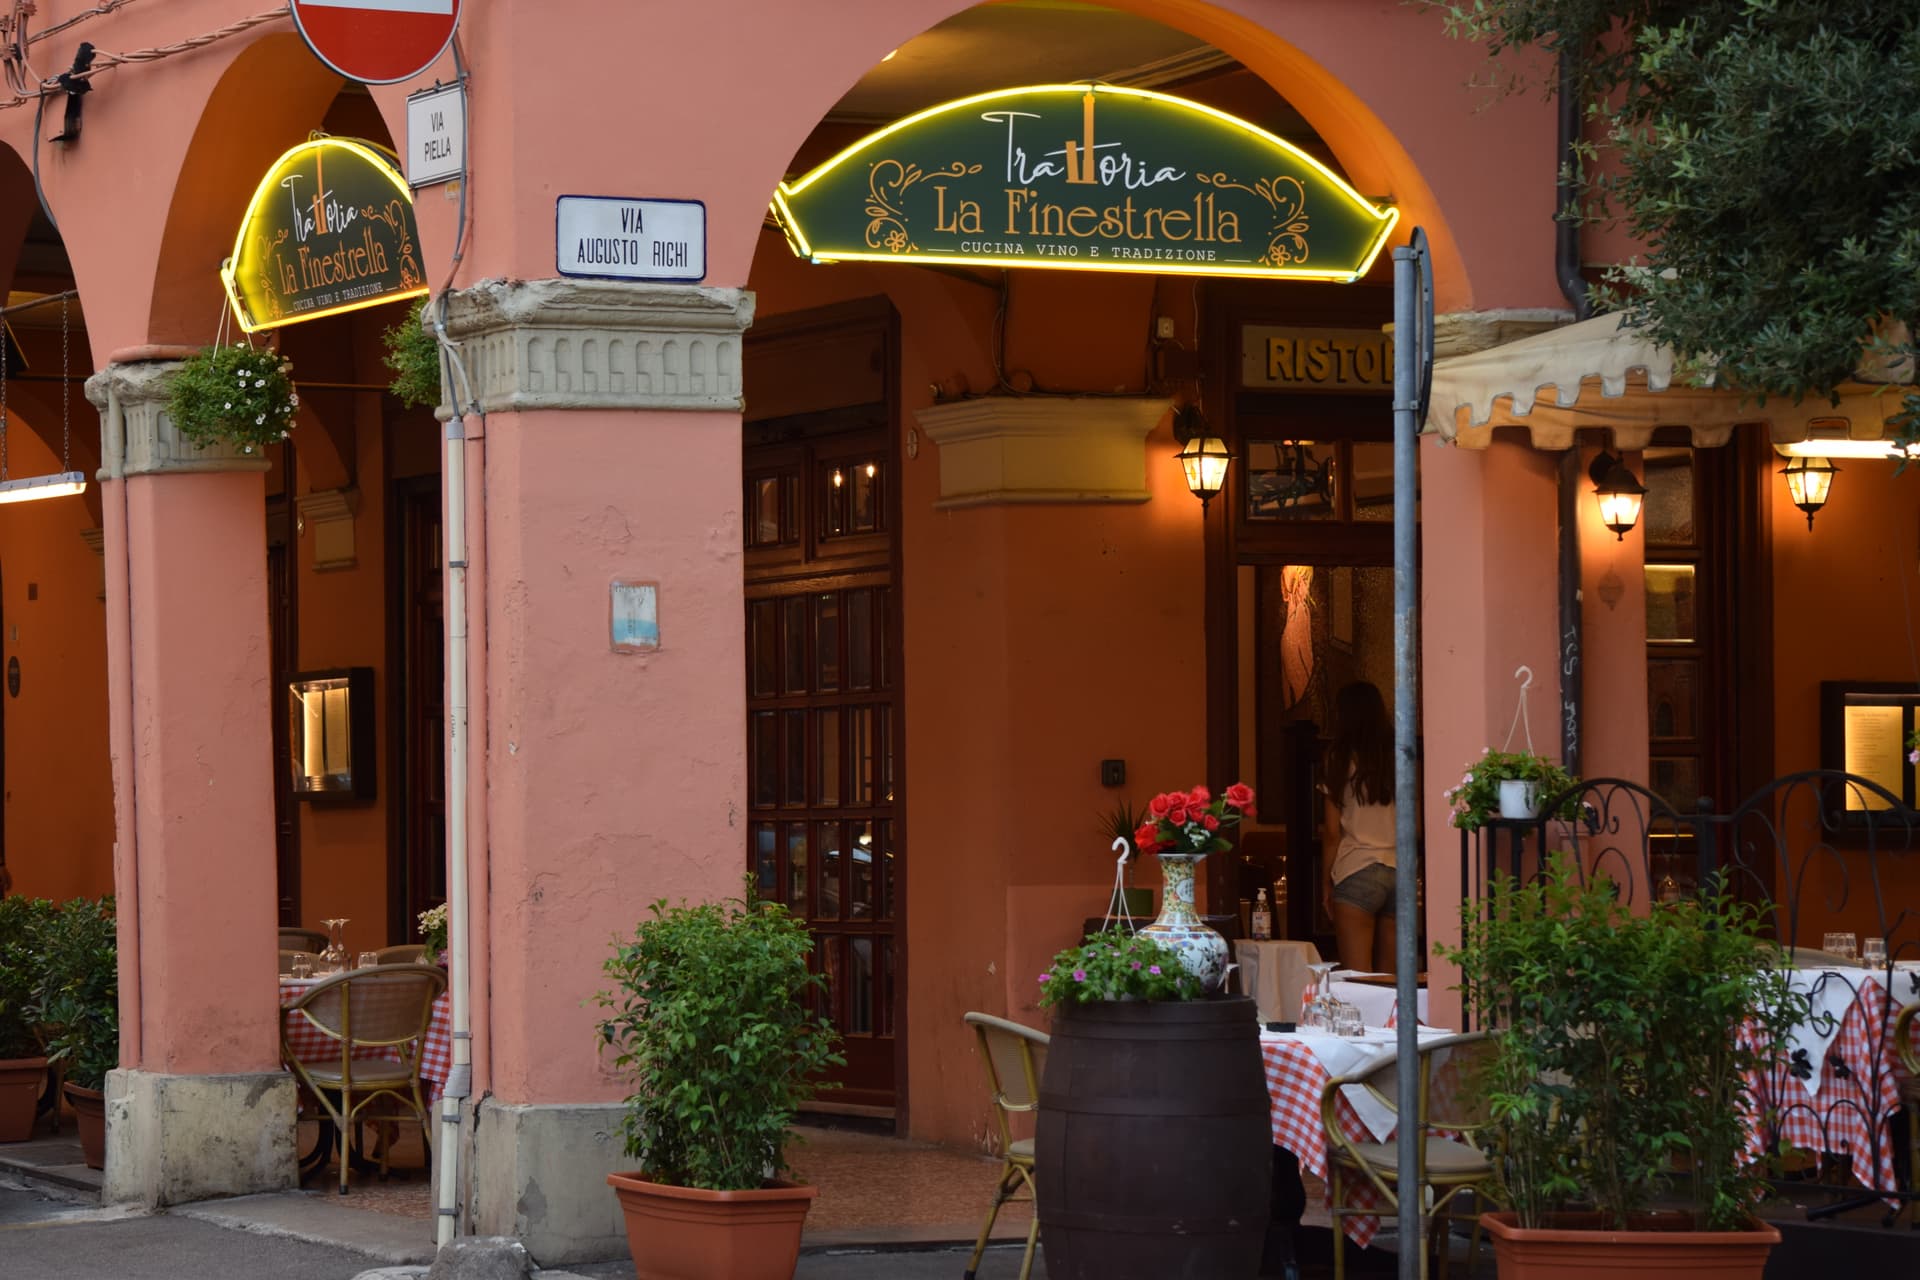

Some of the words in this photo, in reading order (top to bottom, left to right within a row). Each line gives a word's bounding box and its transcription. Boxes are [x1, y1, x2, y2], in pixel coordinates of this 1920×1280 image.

[430, 111, 444, 133] VIA
[424, 136, 451, 161] PIELLA
[981, 92, 1186, 190] Trattoria
[281, 147, 358, 242] Trattoria
[621, 207, 643, 234] VIA
[933, 186, 984, 234] La
[1004, 187, 1242, 243] Finestrella
[276, 253, 299, 295] La
[298, 226, 389, 291] Finestrella
[577, 238, 639, 265] AUGUSTO
[652, 241, 688, 267] RICHI
[961, 241, 1025, 255] CUCINA
[1036, 244, 1079, 257] VINO
[1089, 246, 1100, 257] E
[1111, 247, 1217, 261] TRADIZIONE
[293, 297, 315, 312] CUCINA
[316, 293, 333, 307] VINO
[341, 282, 384, 301] TRADIZIONE
